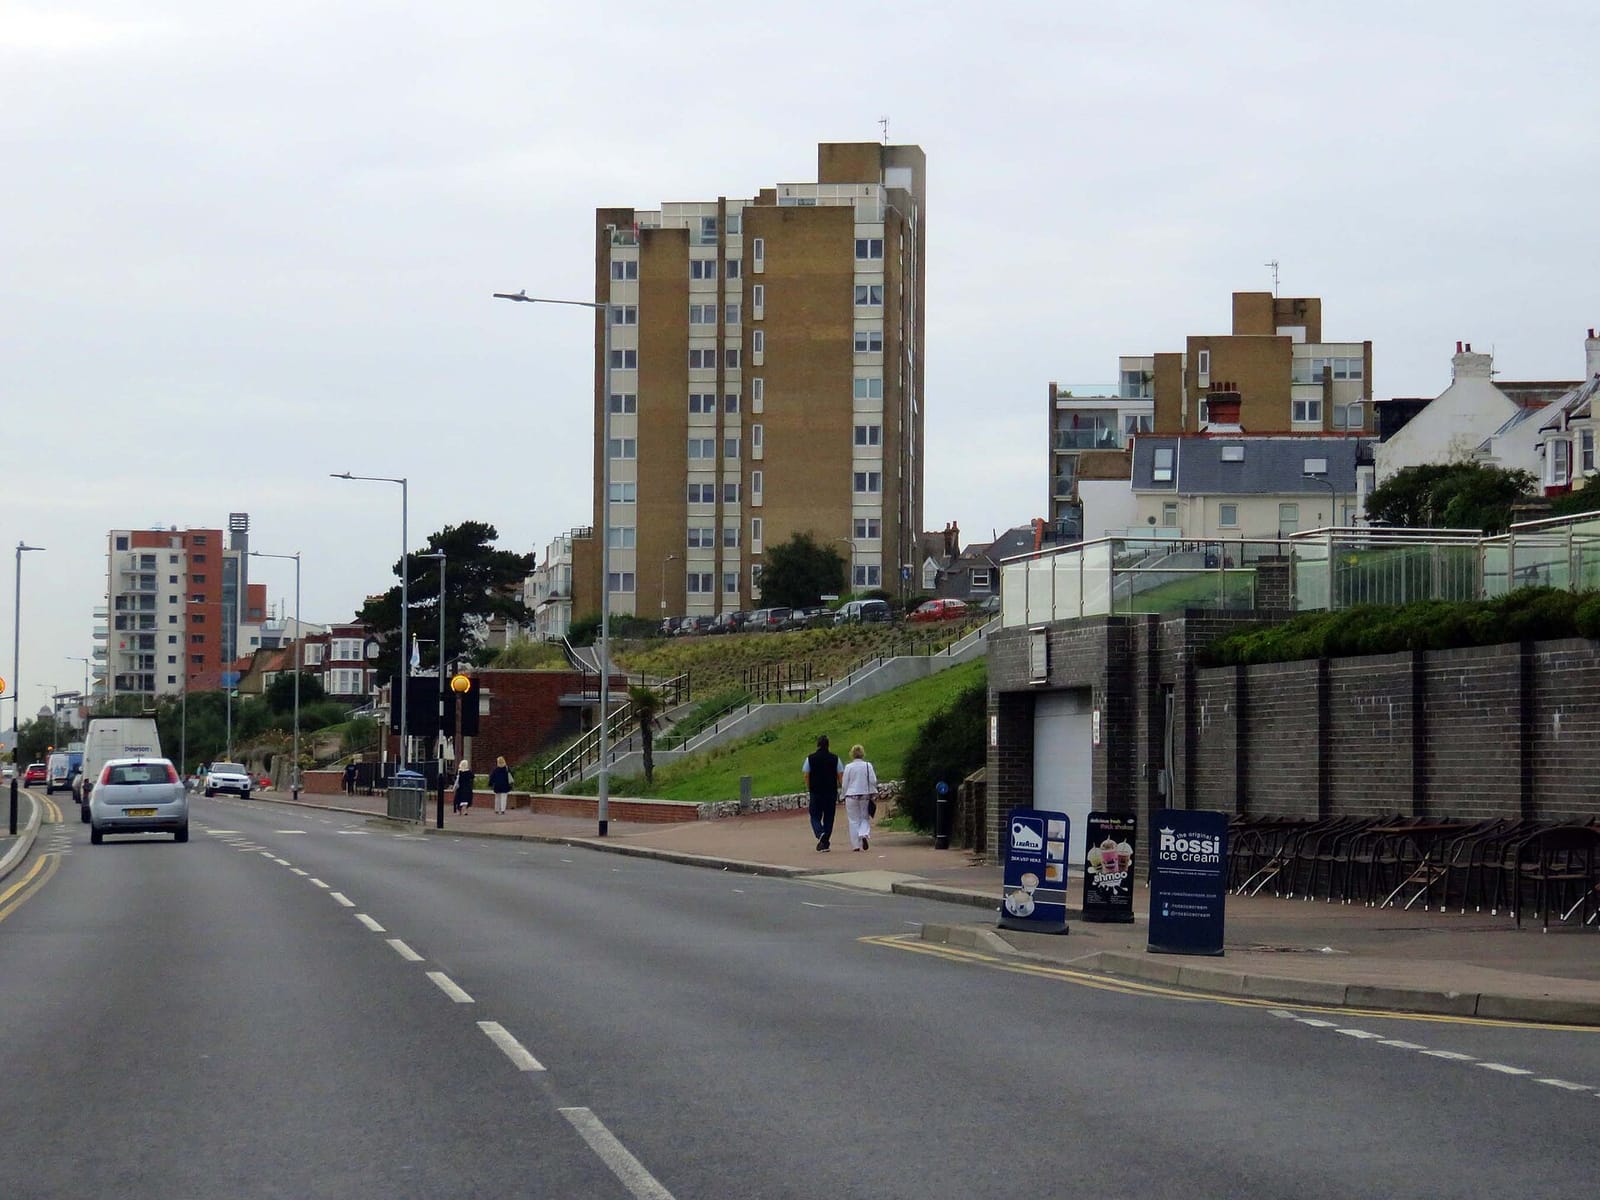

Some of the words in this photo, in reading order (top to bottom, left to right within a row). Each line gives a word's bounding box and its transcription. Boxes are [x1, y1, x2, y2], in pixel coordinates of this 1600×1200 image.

[1160, 834, 1220, 853] Rossi
[1181, 853, 1219, 863] cream
[1094, 871, 1128, 882] shmoo
